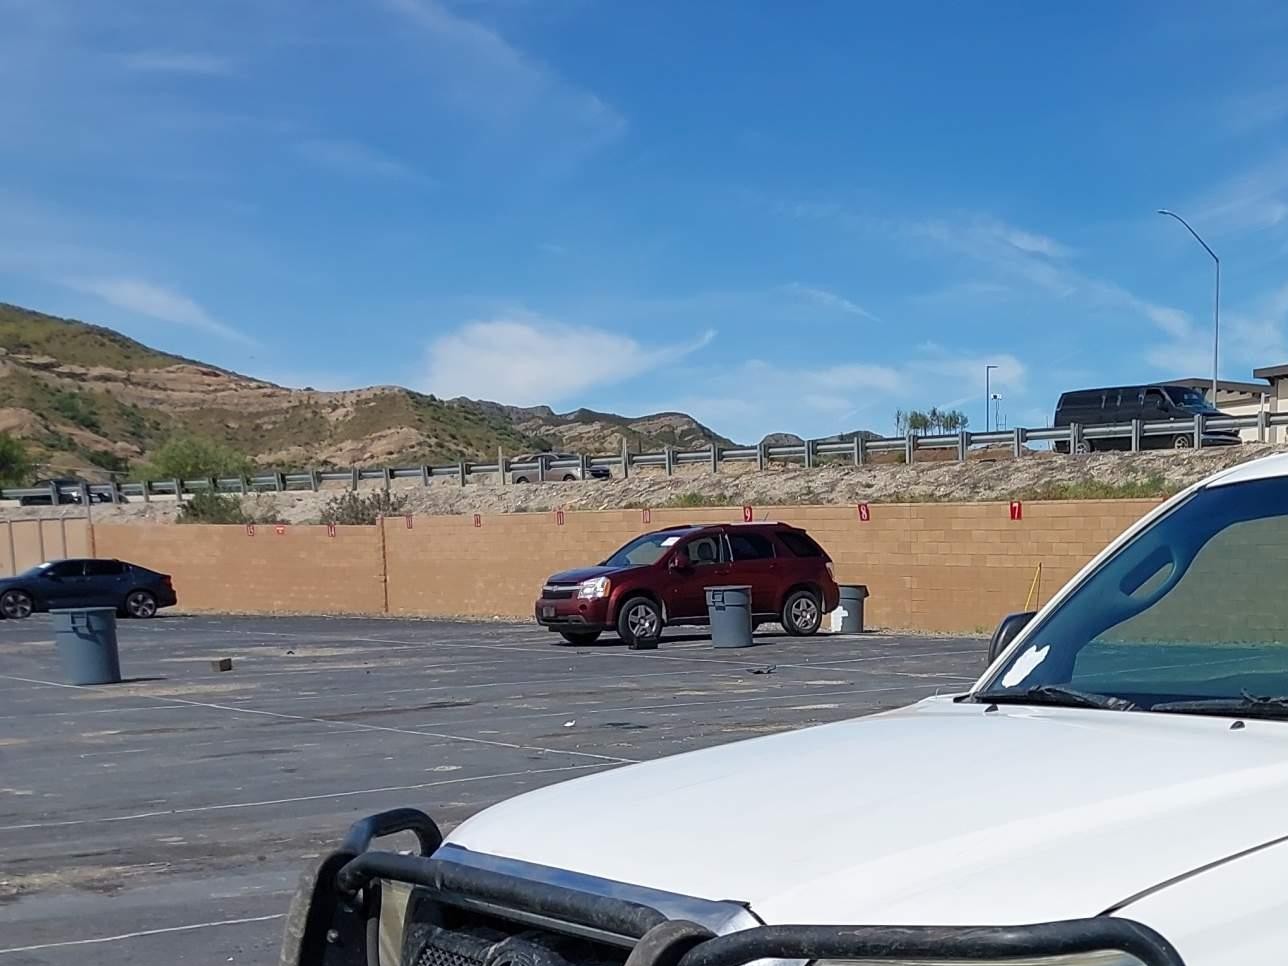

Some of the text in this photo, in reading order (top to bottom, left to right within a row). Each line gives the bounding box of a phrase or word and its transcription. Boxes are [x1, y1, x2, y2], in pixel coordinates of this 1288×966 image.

[744, 507, 751, 521] 9
[860, 504, 868, 520] 8
[1012, 502, 1019, 519] 7
